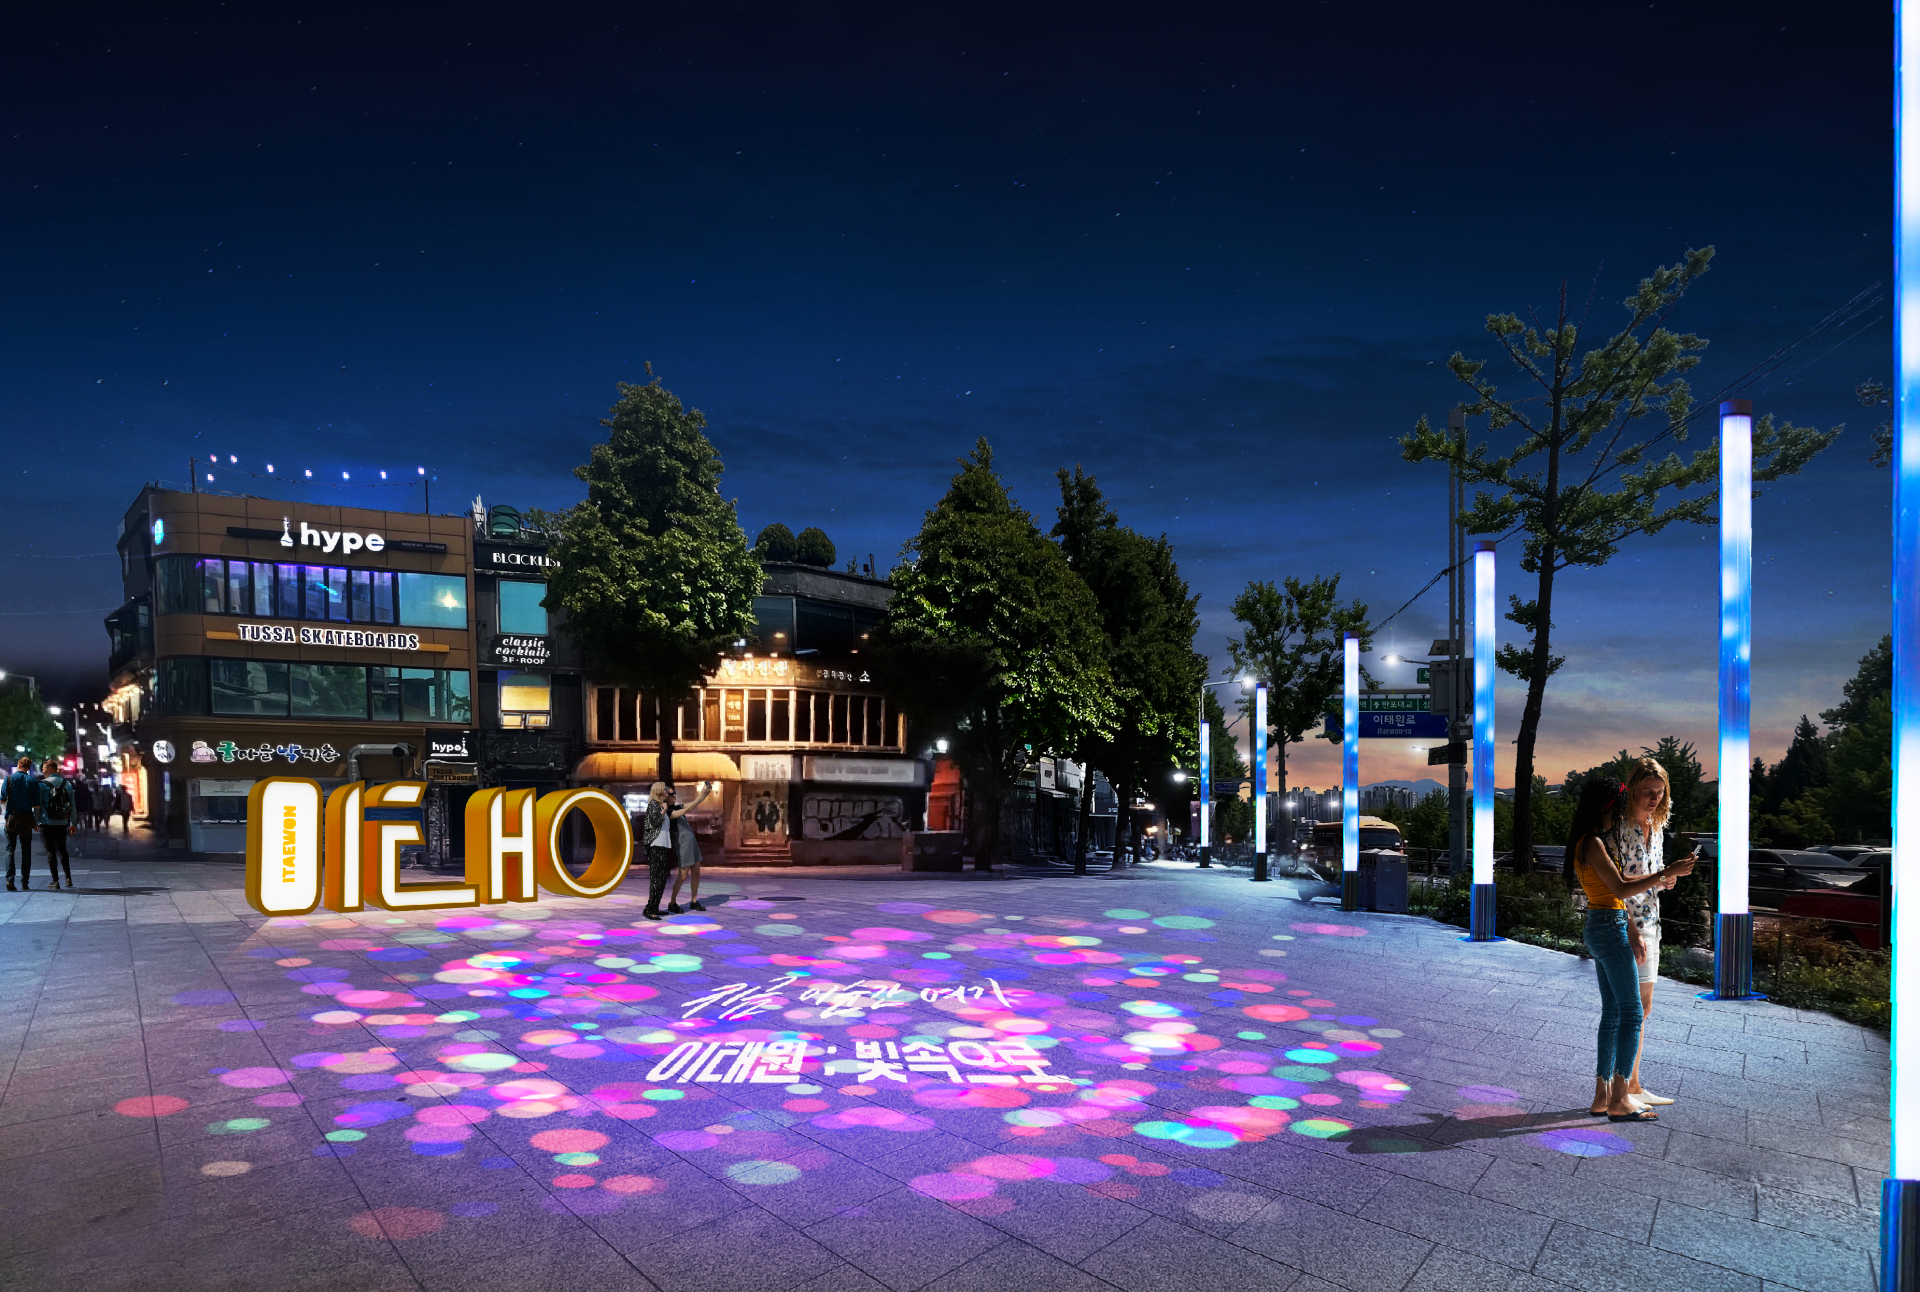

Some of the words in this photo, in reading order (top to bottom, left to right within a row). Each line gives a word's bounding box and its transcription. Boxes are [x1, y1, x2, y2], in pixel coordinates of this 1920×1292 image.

[300, 522, 385, 554] hype
[238, 623, 296, 643] TUSSA
[300, 628, 420, 650] SKATEBOARDS
[502, 636, 545, 648] classic
[495, 646, 551, 658] cocktails
[1382, 701, 1413, 709] 반포대교
[1373, 714, 1416, 726] 이태원로
[432, 741, 462, 753] hype
[282, 805, 297, 884] ITAEWON
[645, 1040, 808, 1084] 이태원
[855, 1040, 1073, 1084] 빛속으로
